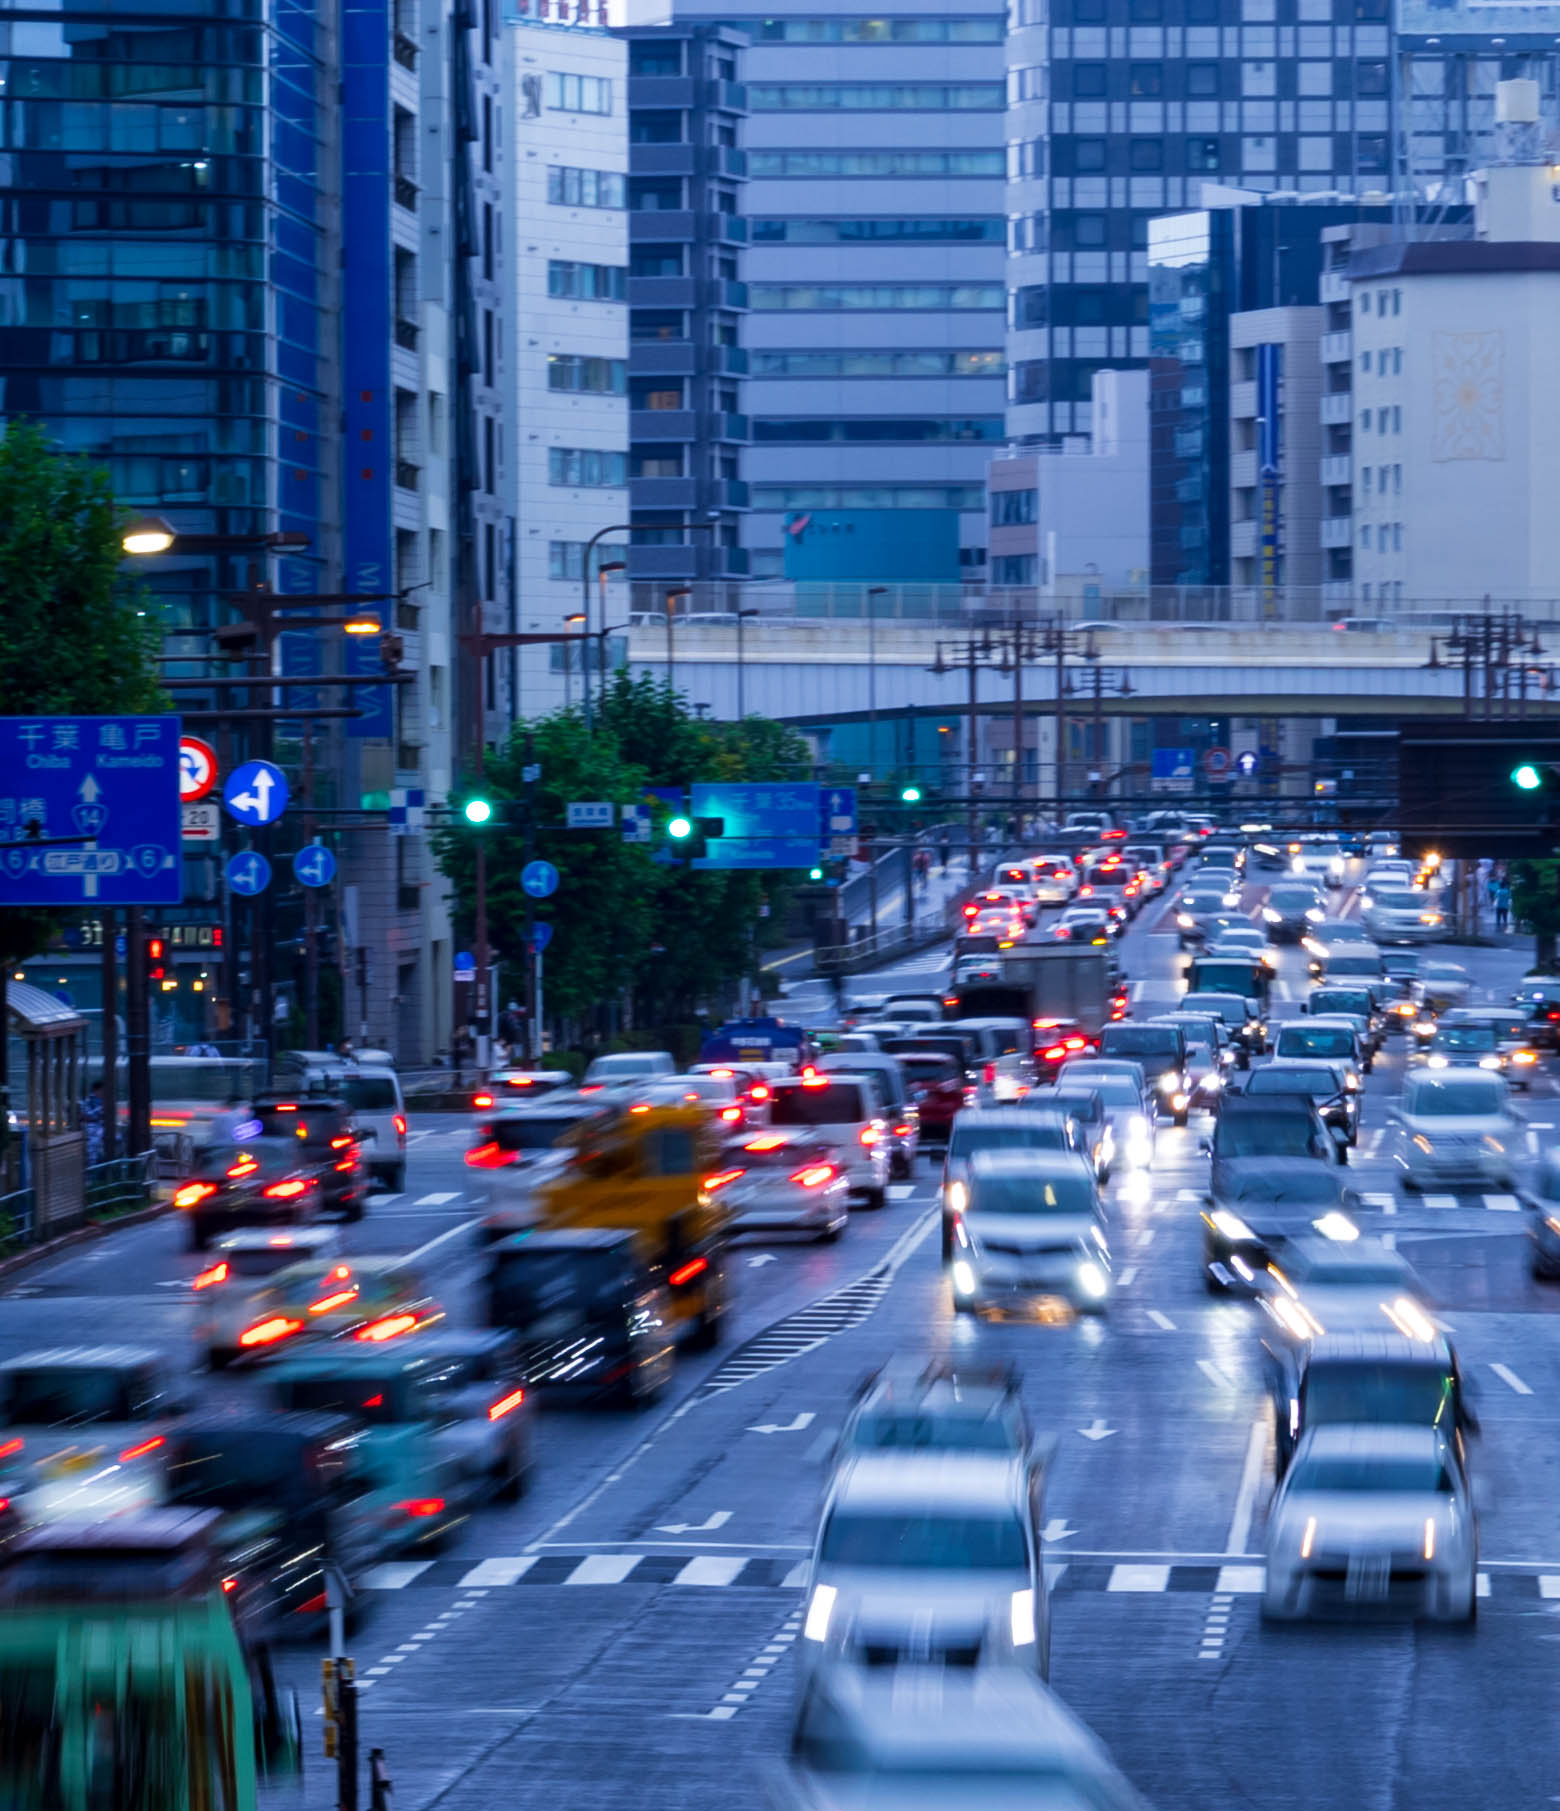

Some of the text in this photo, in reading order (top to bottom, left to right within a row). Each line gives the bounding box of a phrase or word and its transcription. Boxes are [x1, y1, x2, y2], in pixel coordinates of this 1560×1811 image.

[17, 724, 162, 751] 千葉 亀戸
[79, 809, 100, 827] 14
[9, 850, 22, 868] 6
[141, 849, 154, 868] 6
